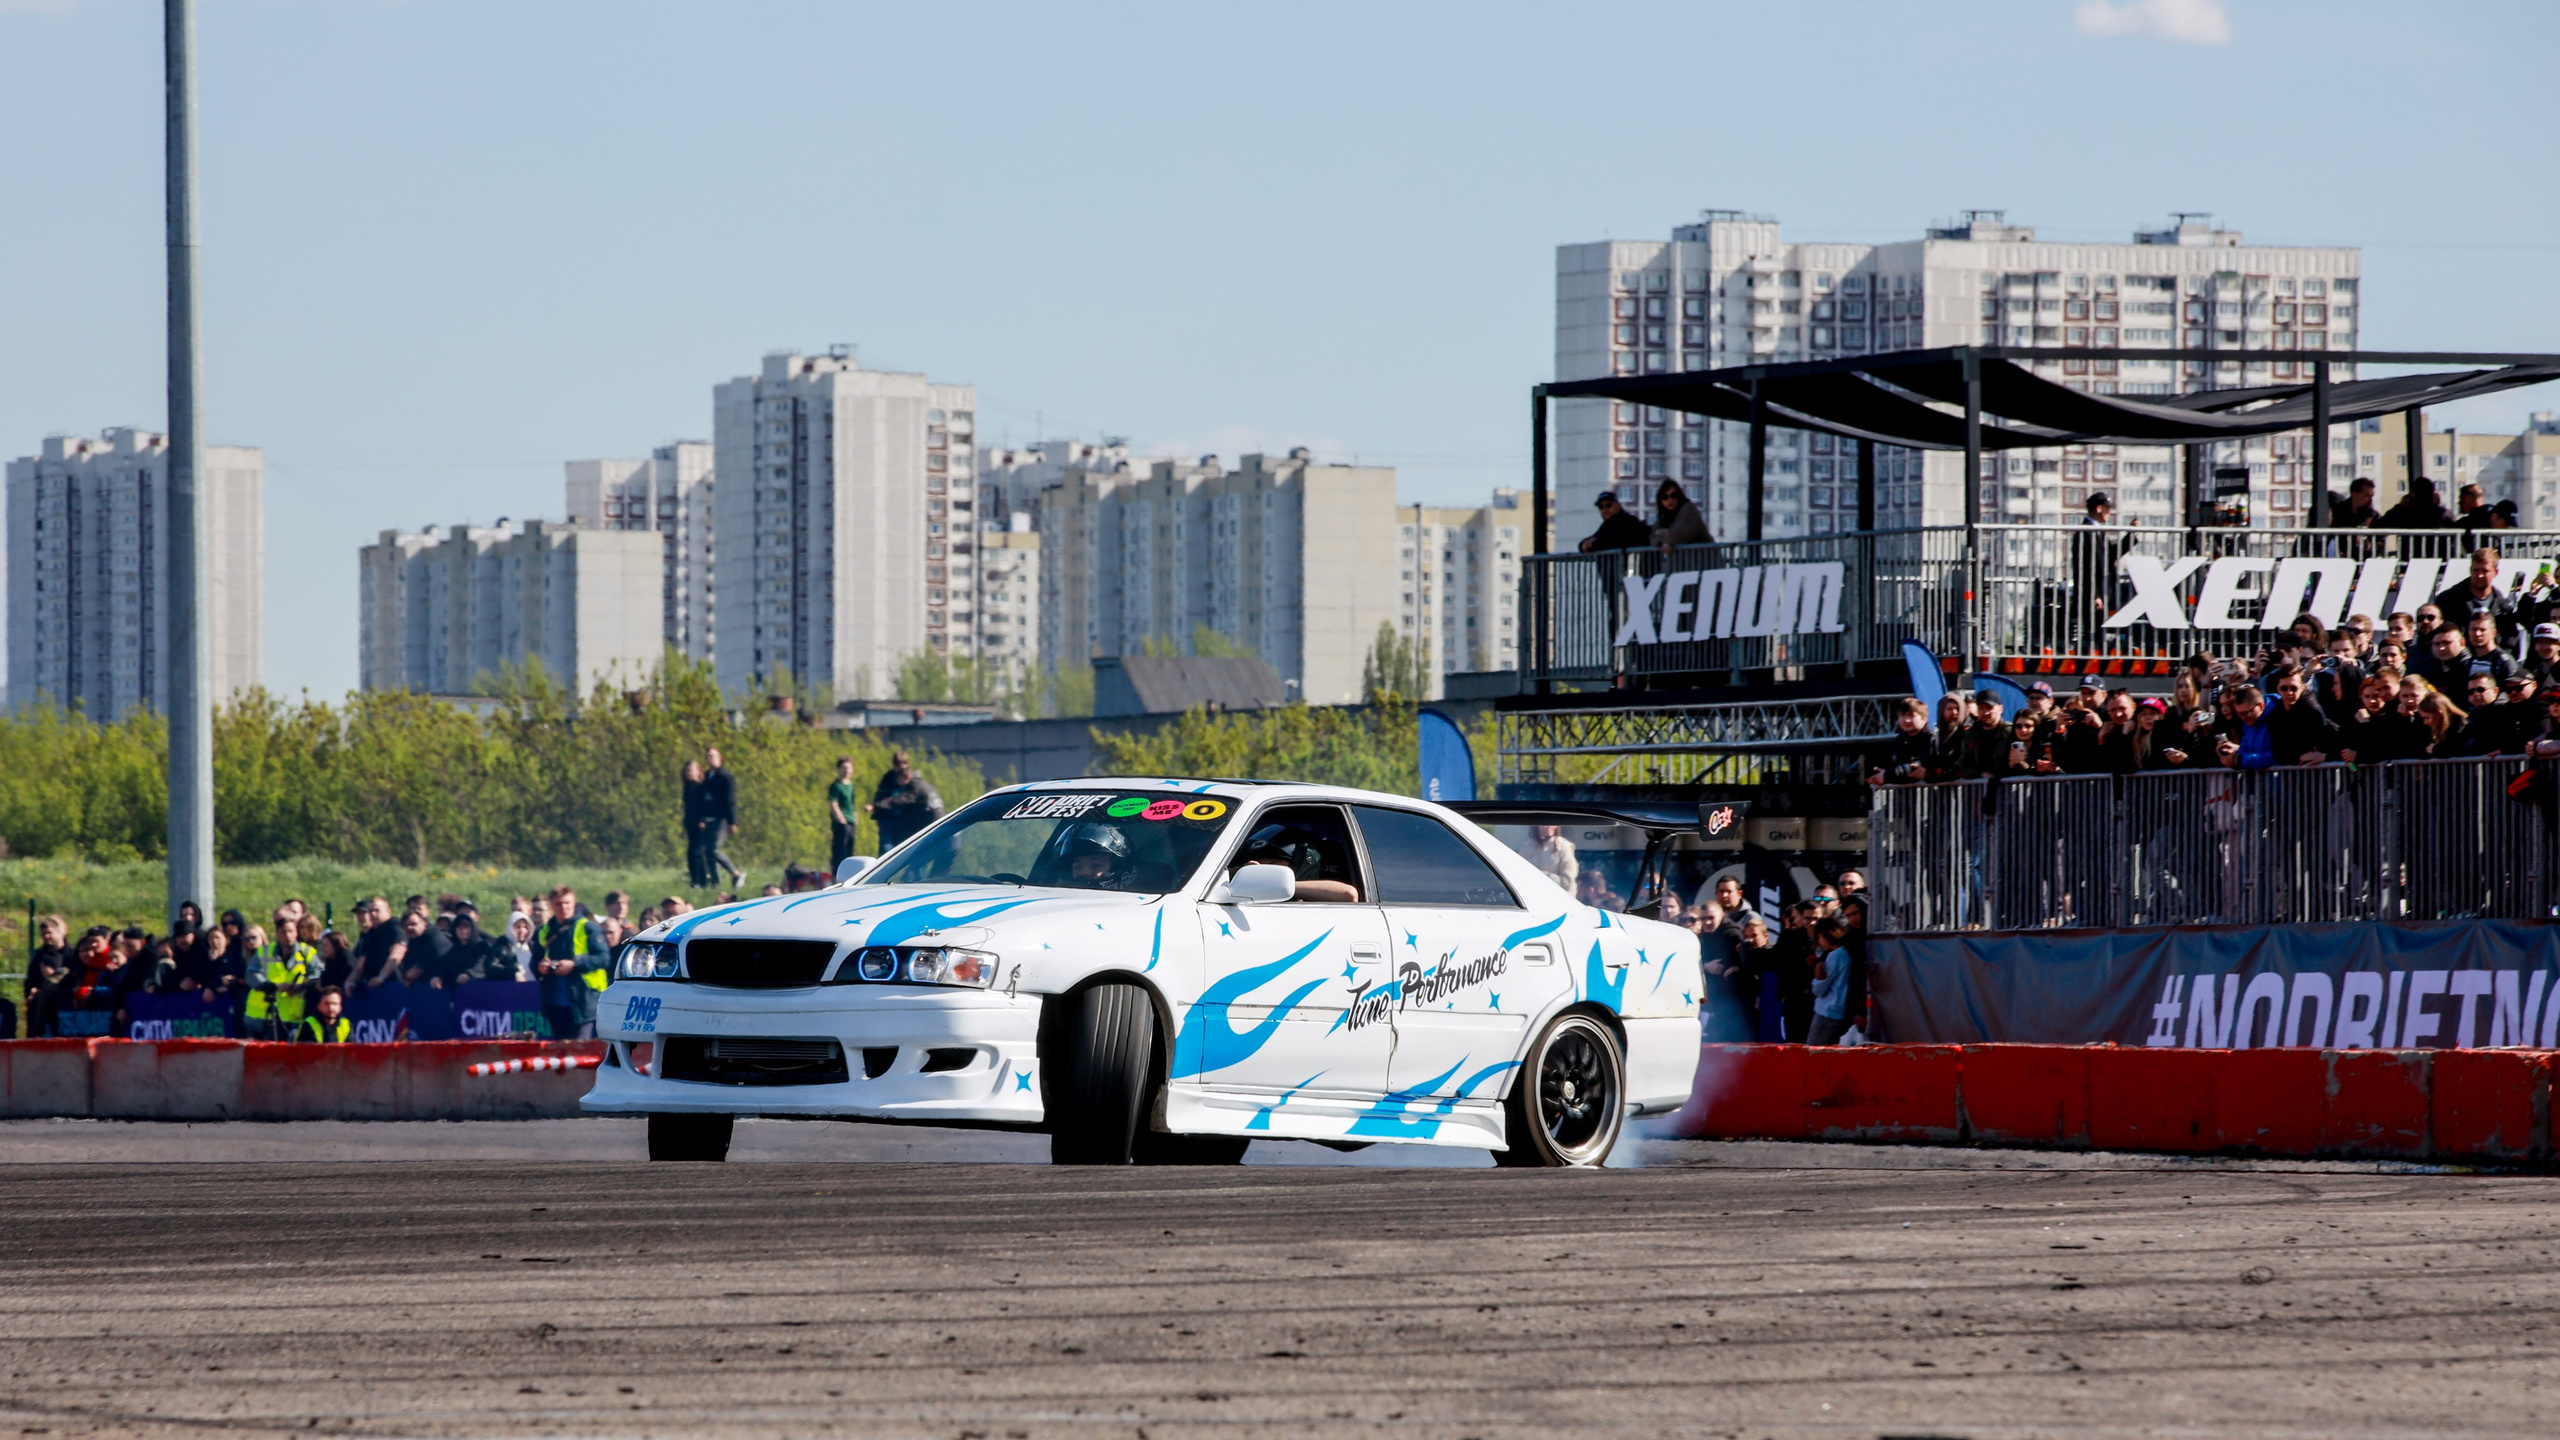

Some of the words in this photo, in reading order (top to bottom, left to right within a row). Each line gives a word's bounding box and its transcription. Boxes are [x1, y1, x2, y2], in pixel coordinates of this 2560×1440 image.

[1614, 561, 1845, 646] XENUM
[1043, 806, 1094, 818] FEST
[1055, 795, 1117, 807] DRIFT
[1346, 978, 1389, 1032] Tune
[1399, 949, 1507, 1015] Performance
[625, 996, 662, 1023] DNB
